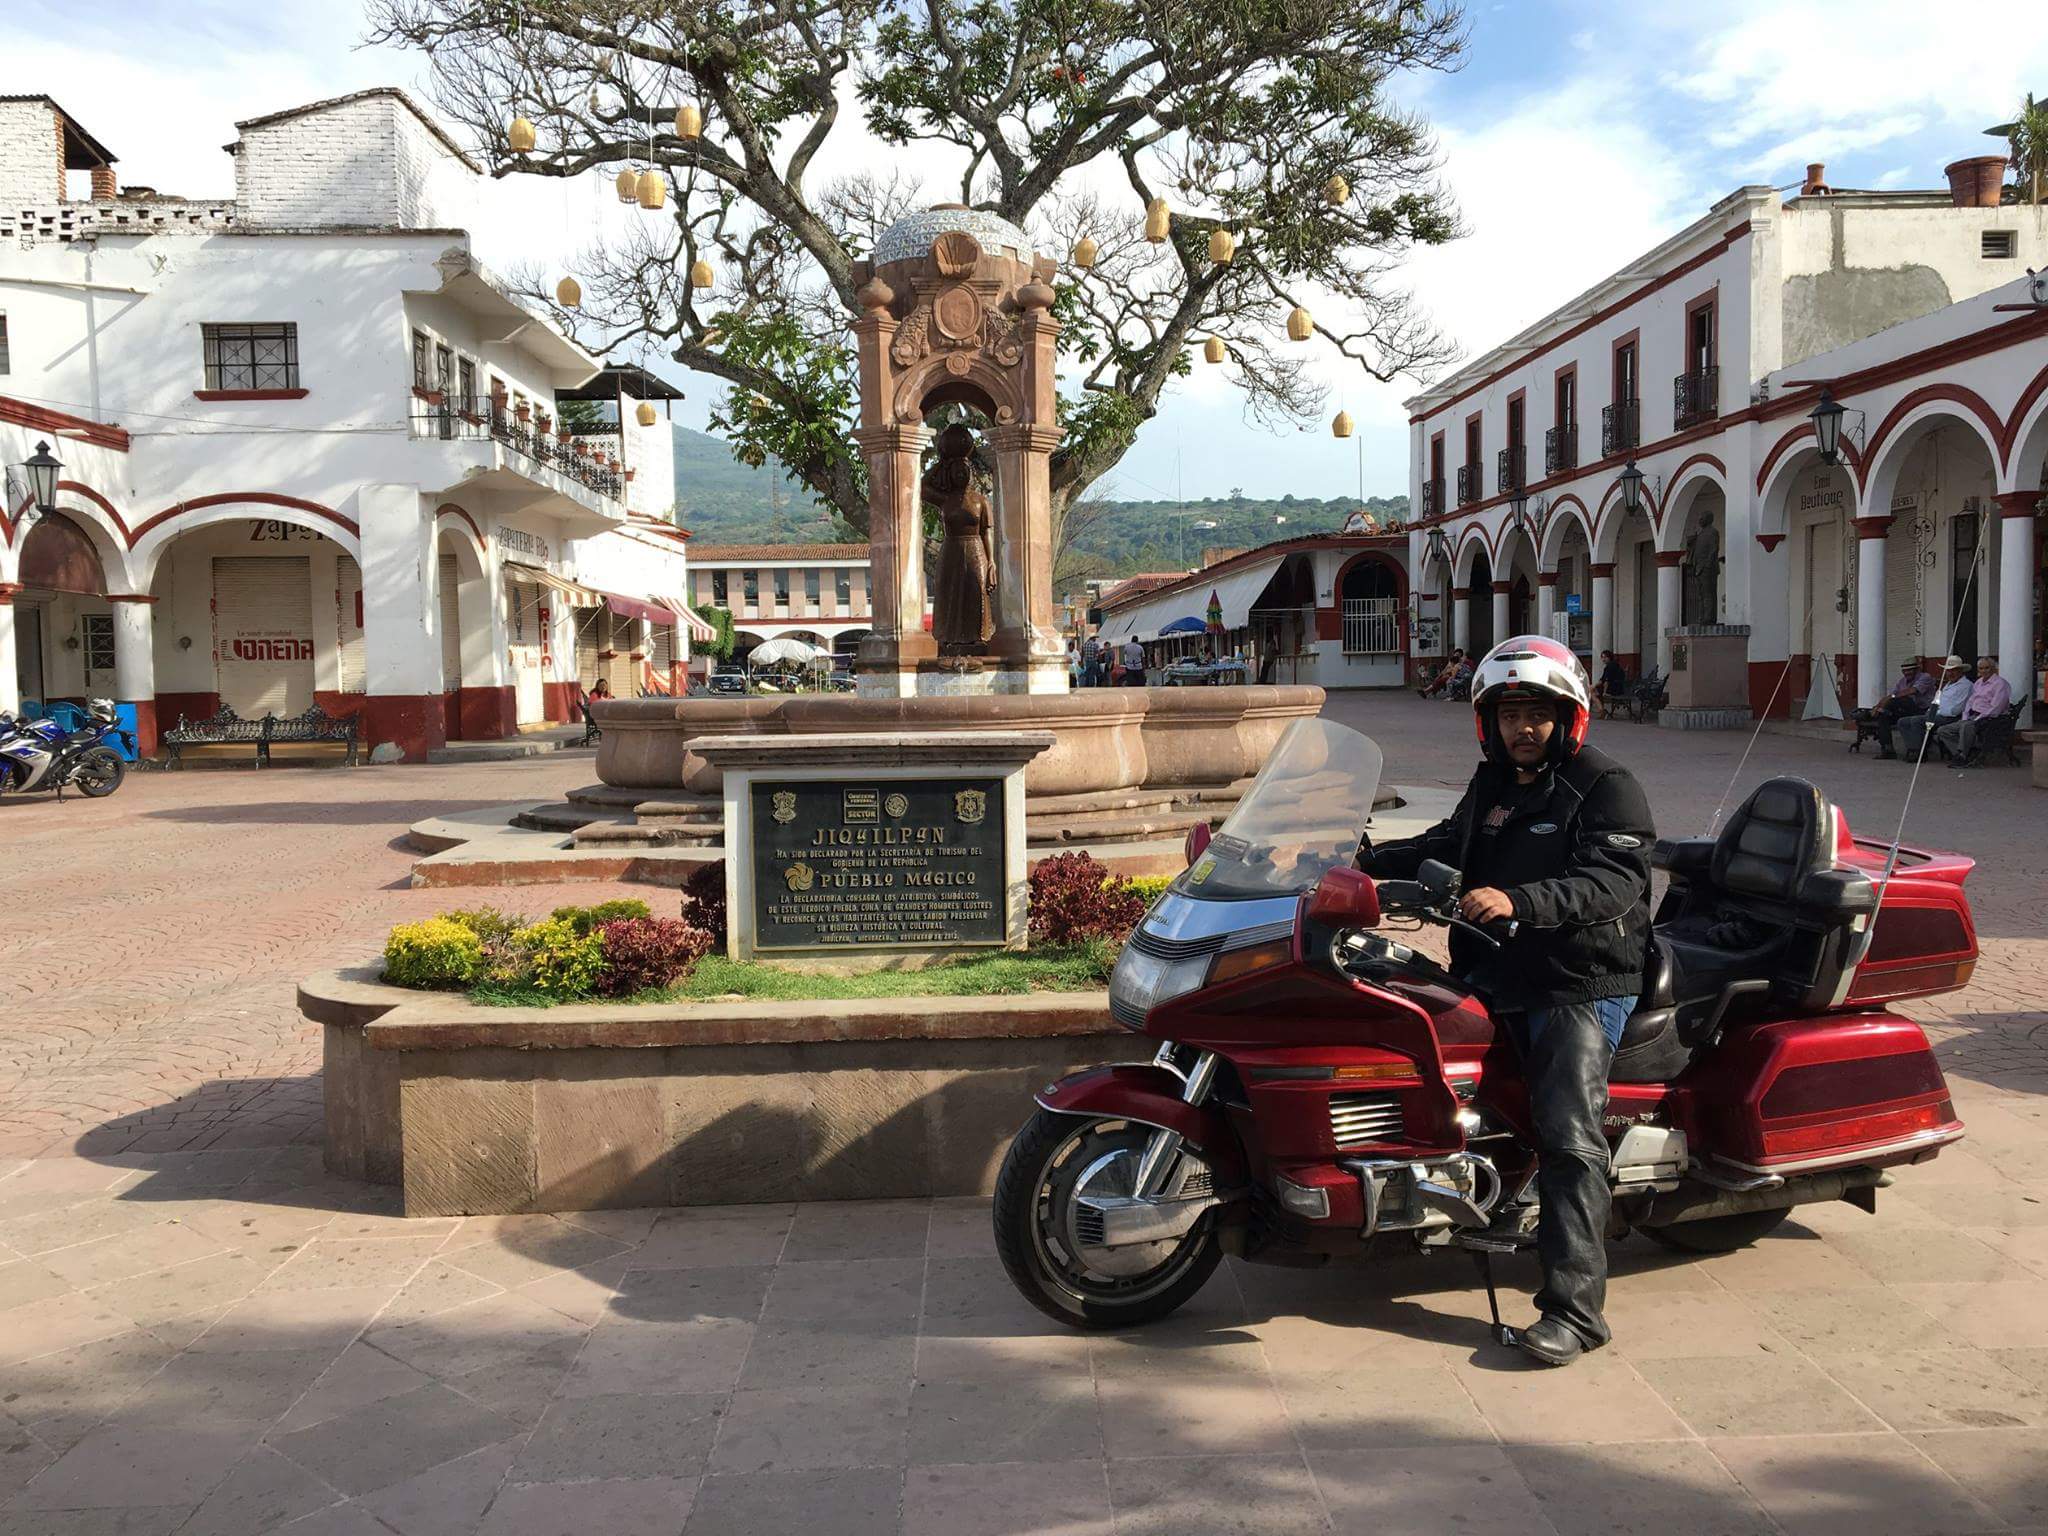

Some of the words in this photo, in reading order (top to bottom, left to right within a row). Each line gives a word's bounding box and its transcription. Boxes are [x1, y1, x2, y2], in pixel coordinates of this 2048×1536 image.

[812, 827, 944, 845] JIQUILPAN
[810, 849, 848, 858] DECLARADO
[851, 849, 864, 857] POR
[867, 849, 876, 857] LA
[925, 848, 934, 856] DE
[820, 873, 894, 888] PUEBLO
